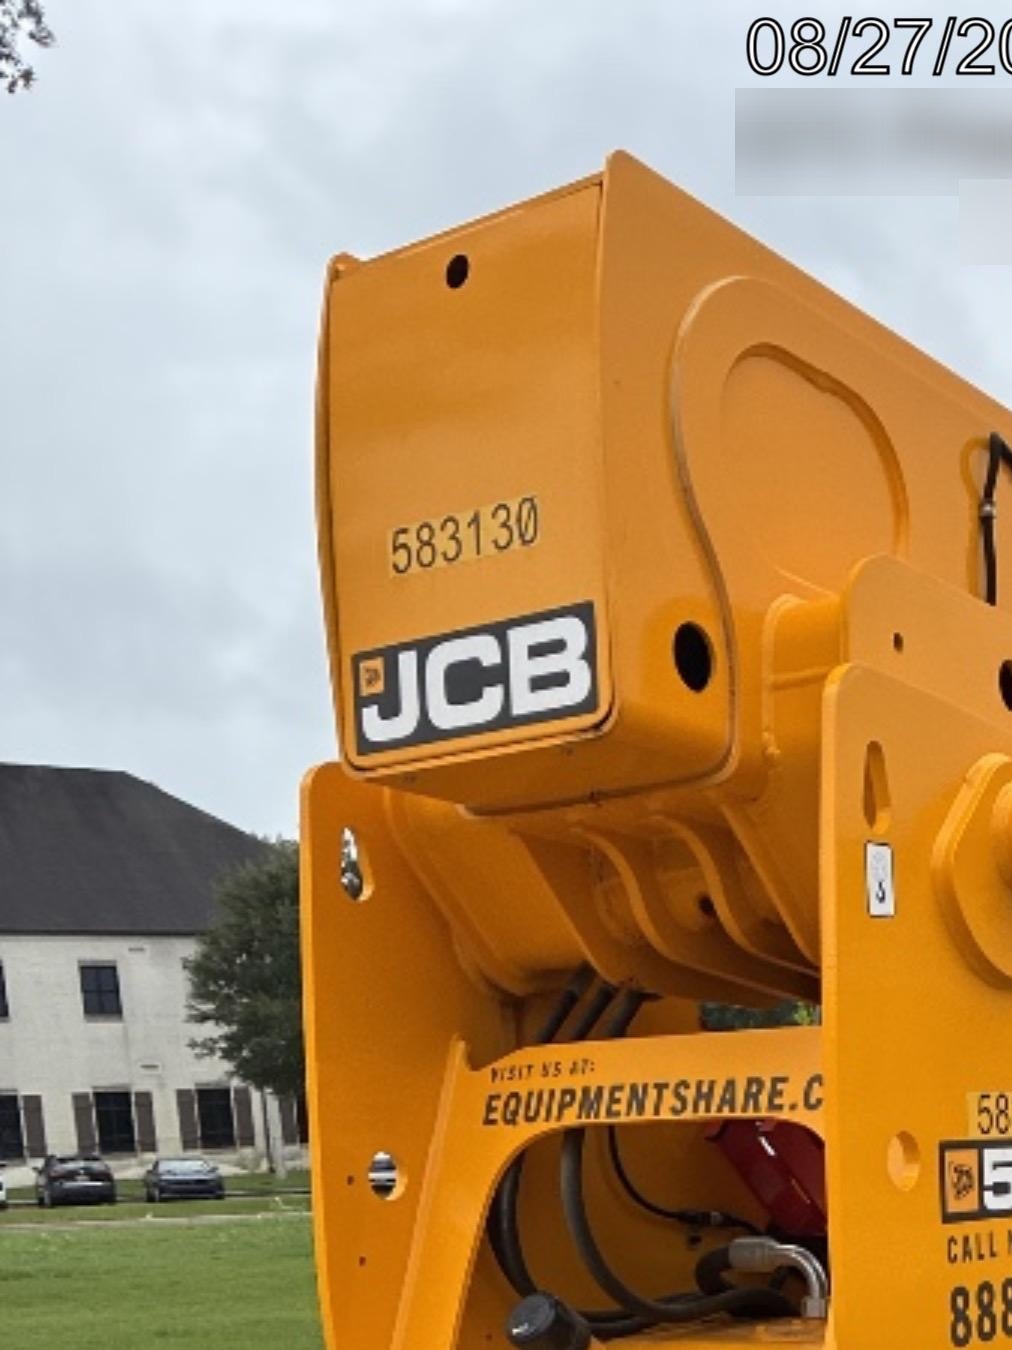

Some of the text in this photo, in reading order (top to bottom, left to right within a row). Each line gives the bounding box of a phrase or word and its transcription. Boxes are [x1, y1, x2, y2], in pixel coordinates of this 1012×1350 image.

[391, 496, 539, 575] 583130
[361, 615, 593, 743] JCB
[946, 1230, 997, 1264] CALL
